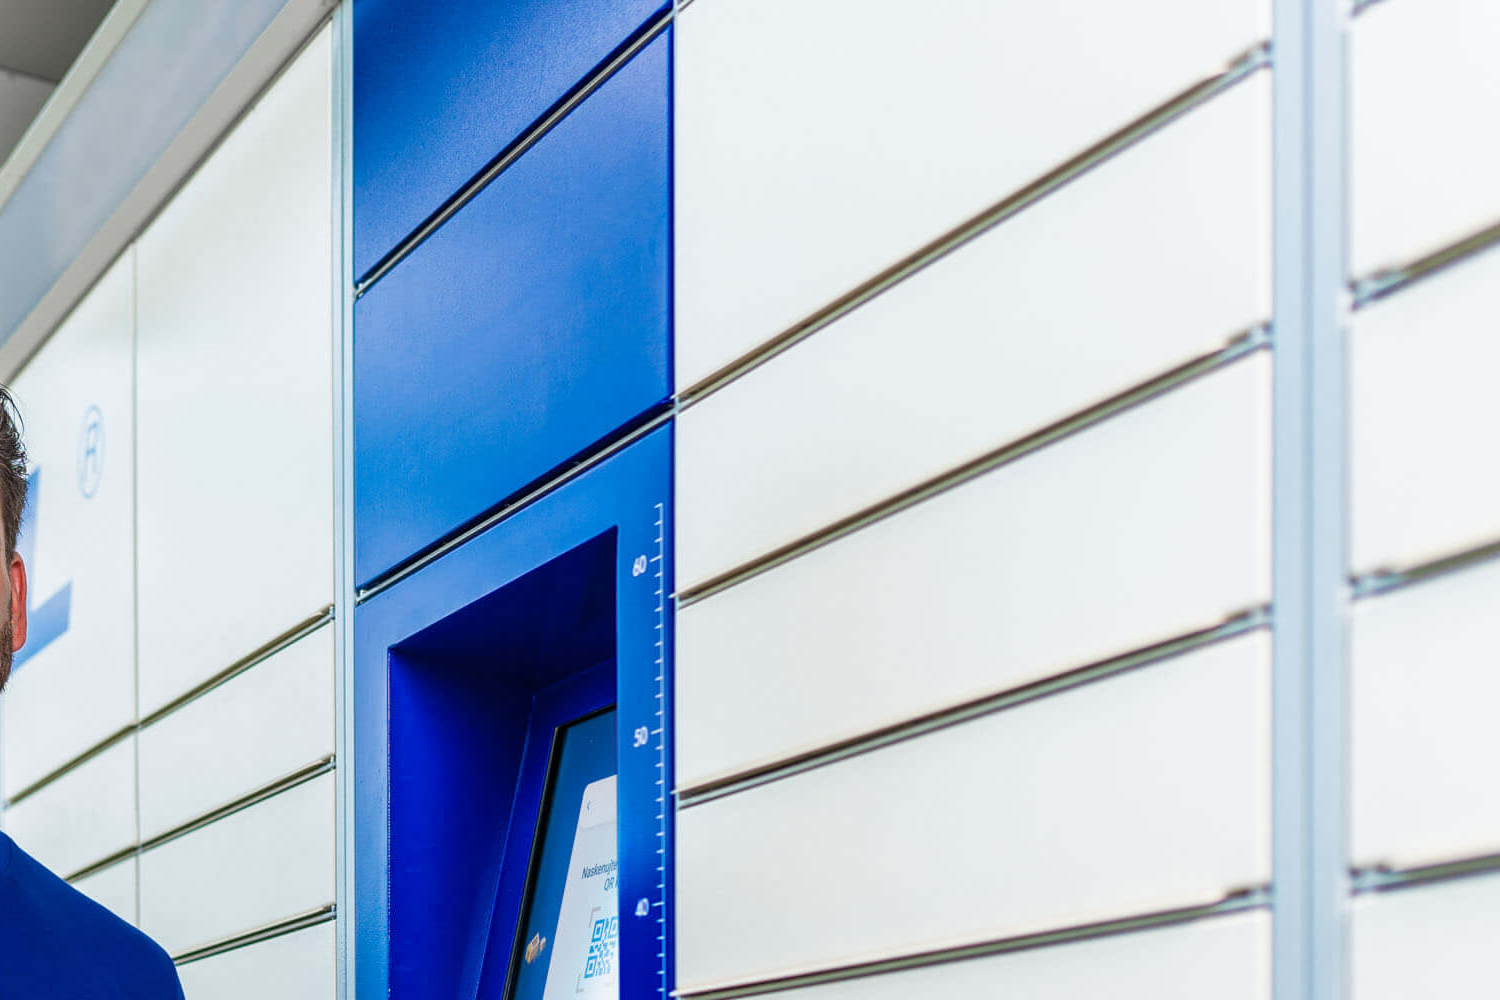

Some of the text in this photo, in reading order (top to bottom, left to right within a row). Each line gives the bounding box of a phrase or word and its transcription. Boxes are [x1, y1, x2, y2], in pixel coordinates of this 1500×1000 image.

[632, 555, 647, 577] 60
[633, 726, 649, 748] 50
[635, 898, 649, 916] 40
